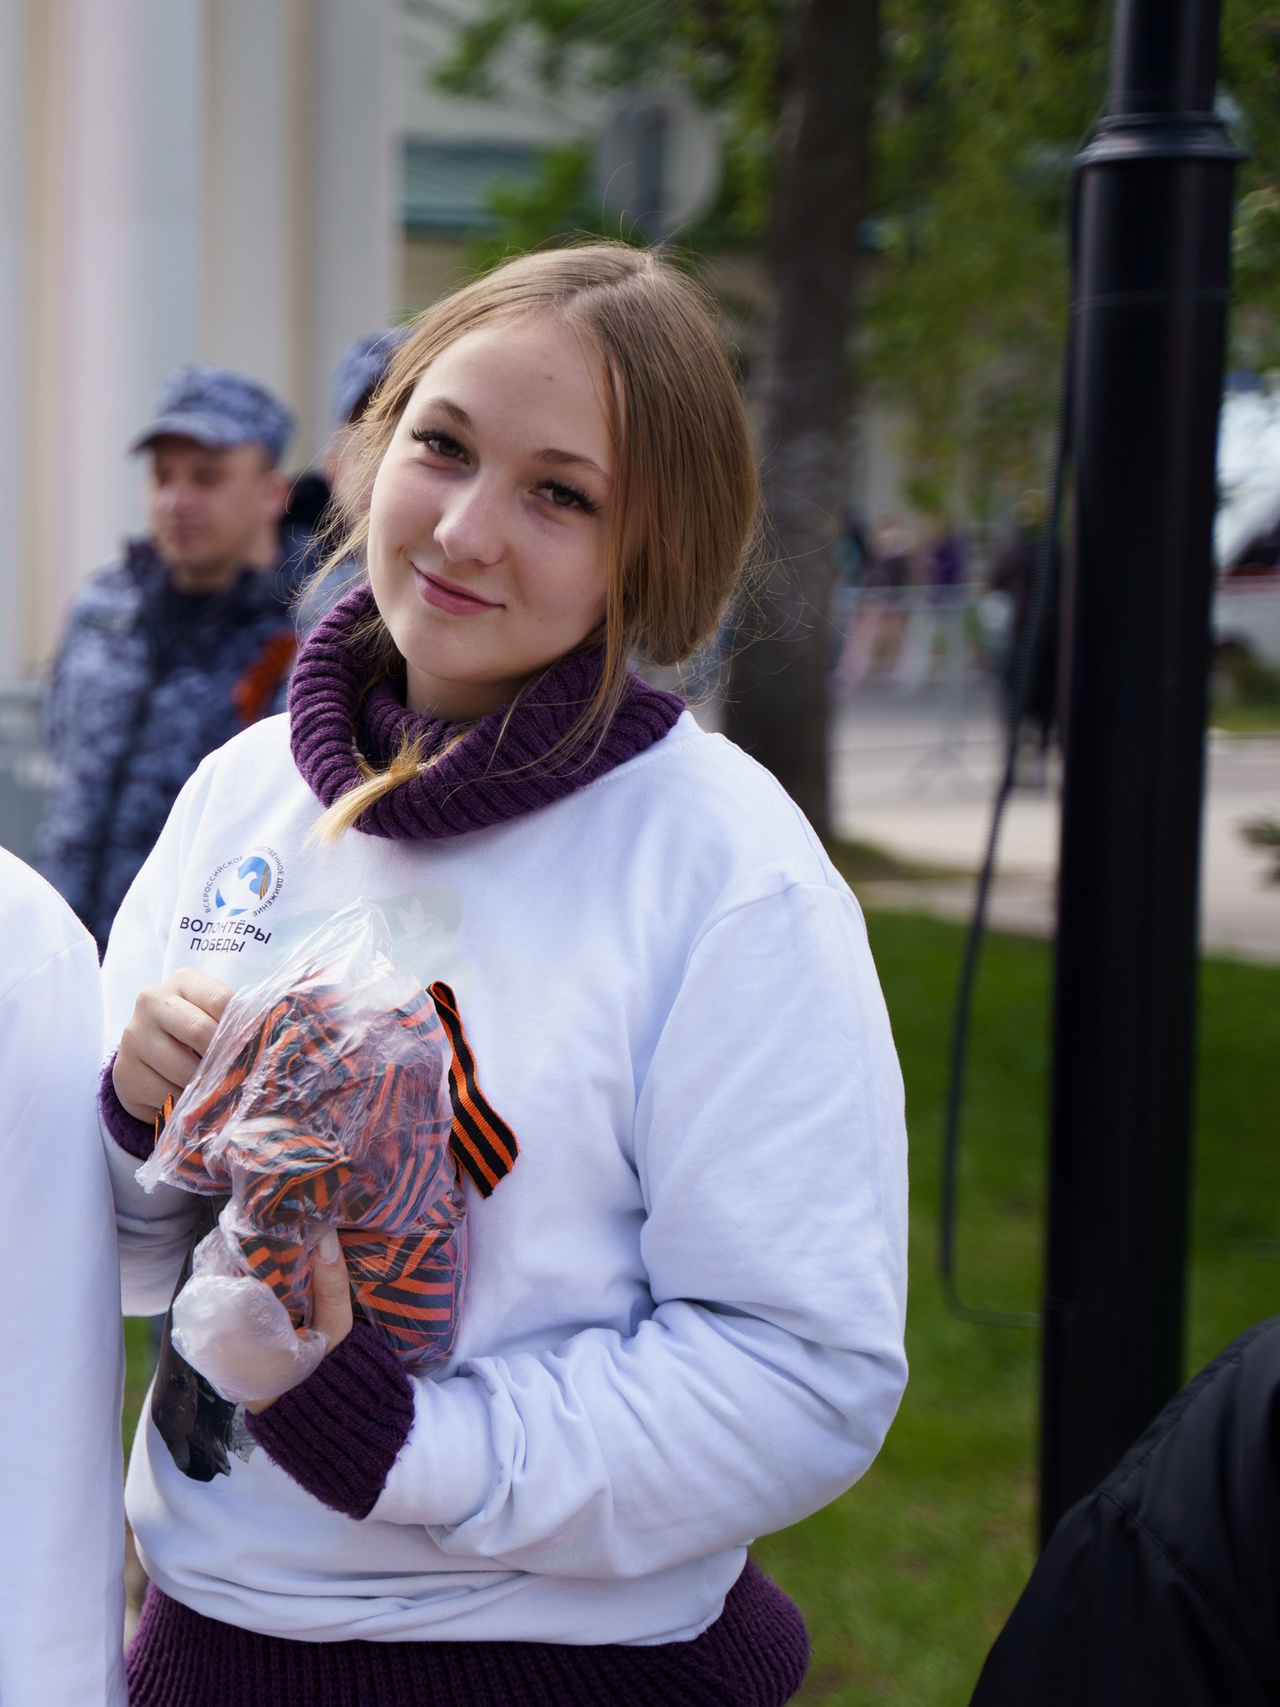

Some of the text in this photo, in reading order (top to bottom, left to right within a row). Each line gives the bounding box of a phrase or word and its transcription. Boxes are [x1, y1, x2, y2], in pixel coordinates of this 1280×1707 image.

[252, 877, 284, 917] ДВИЖЕНИЕ
[180, 917, 272, 944] ВОЛОНТЁРЫ
[190, 938, 246, 953] ПОБЕДЫ
